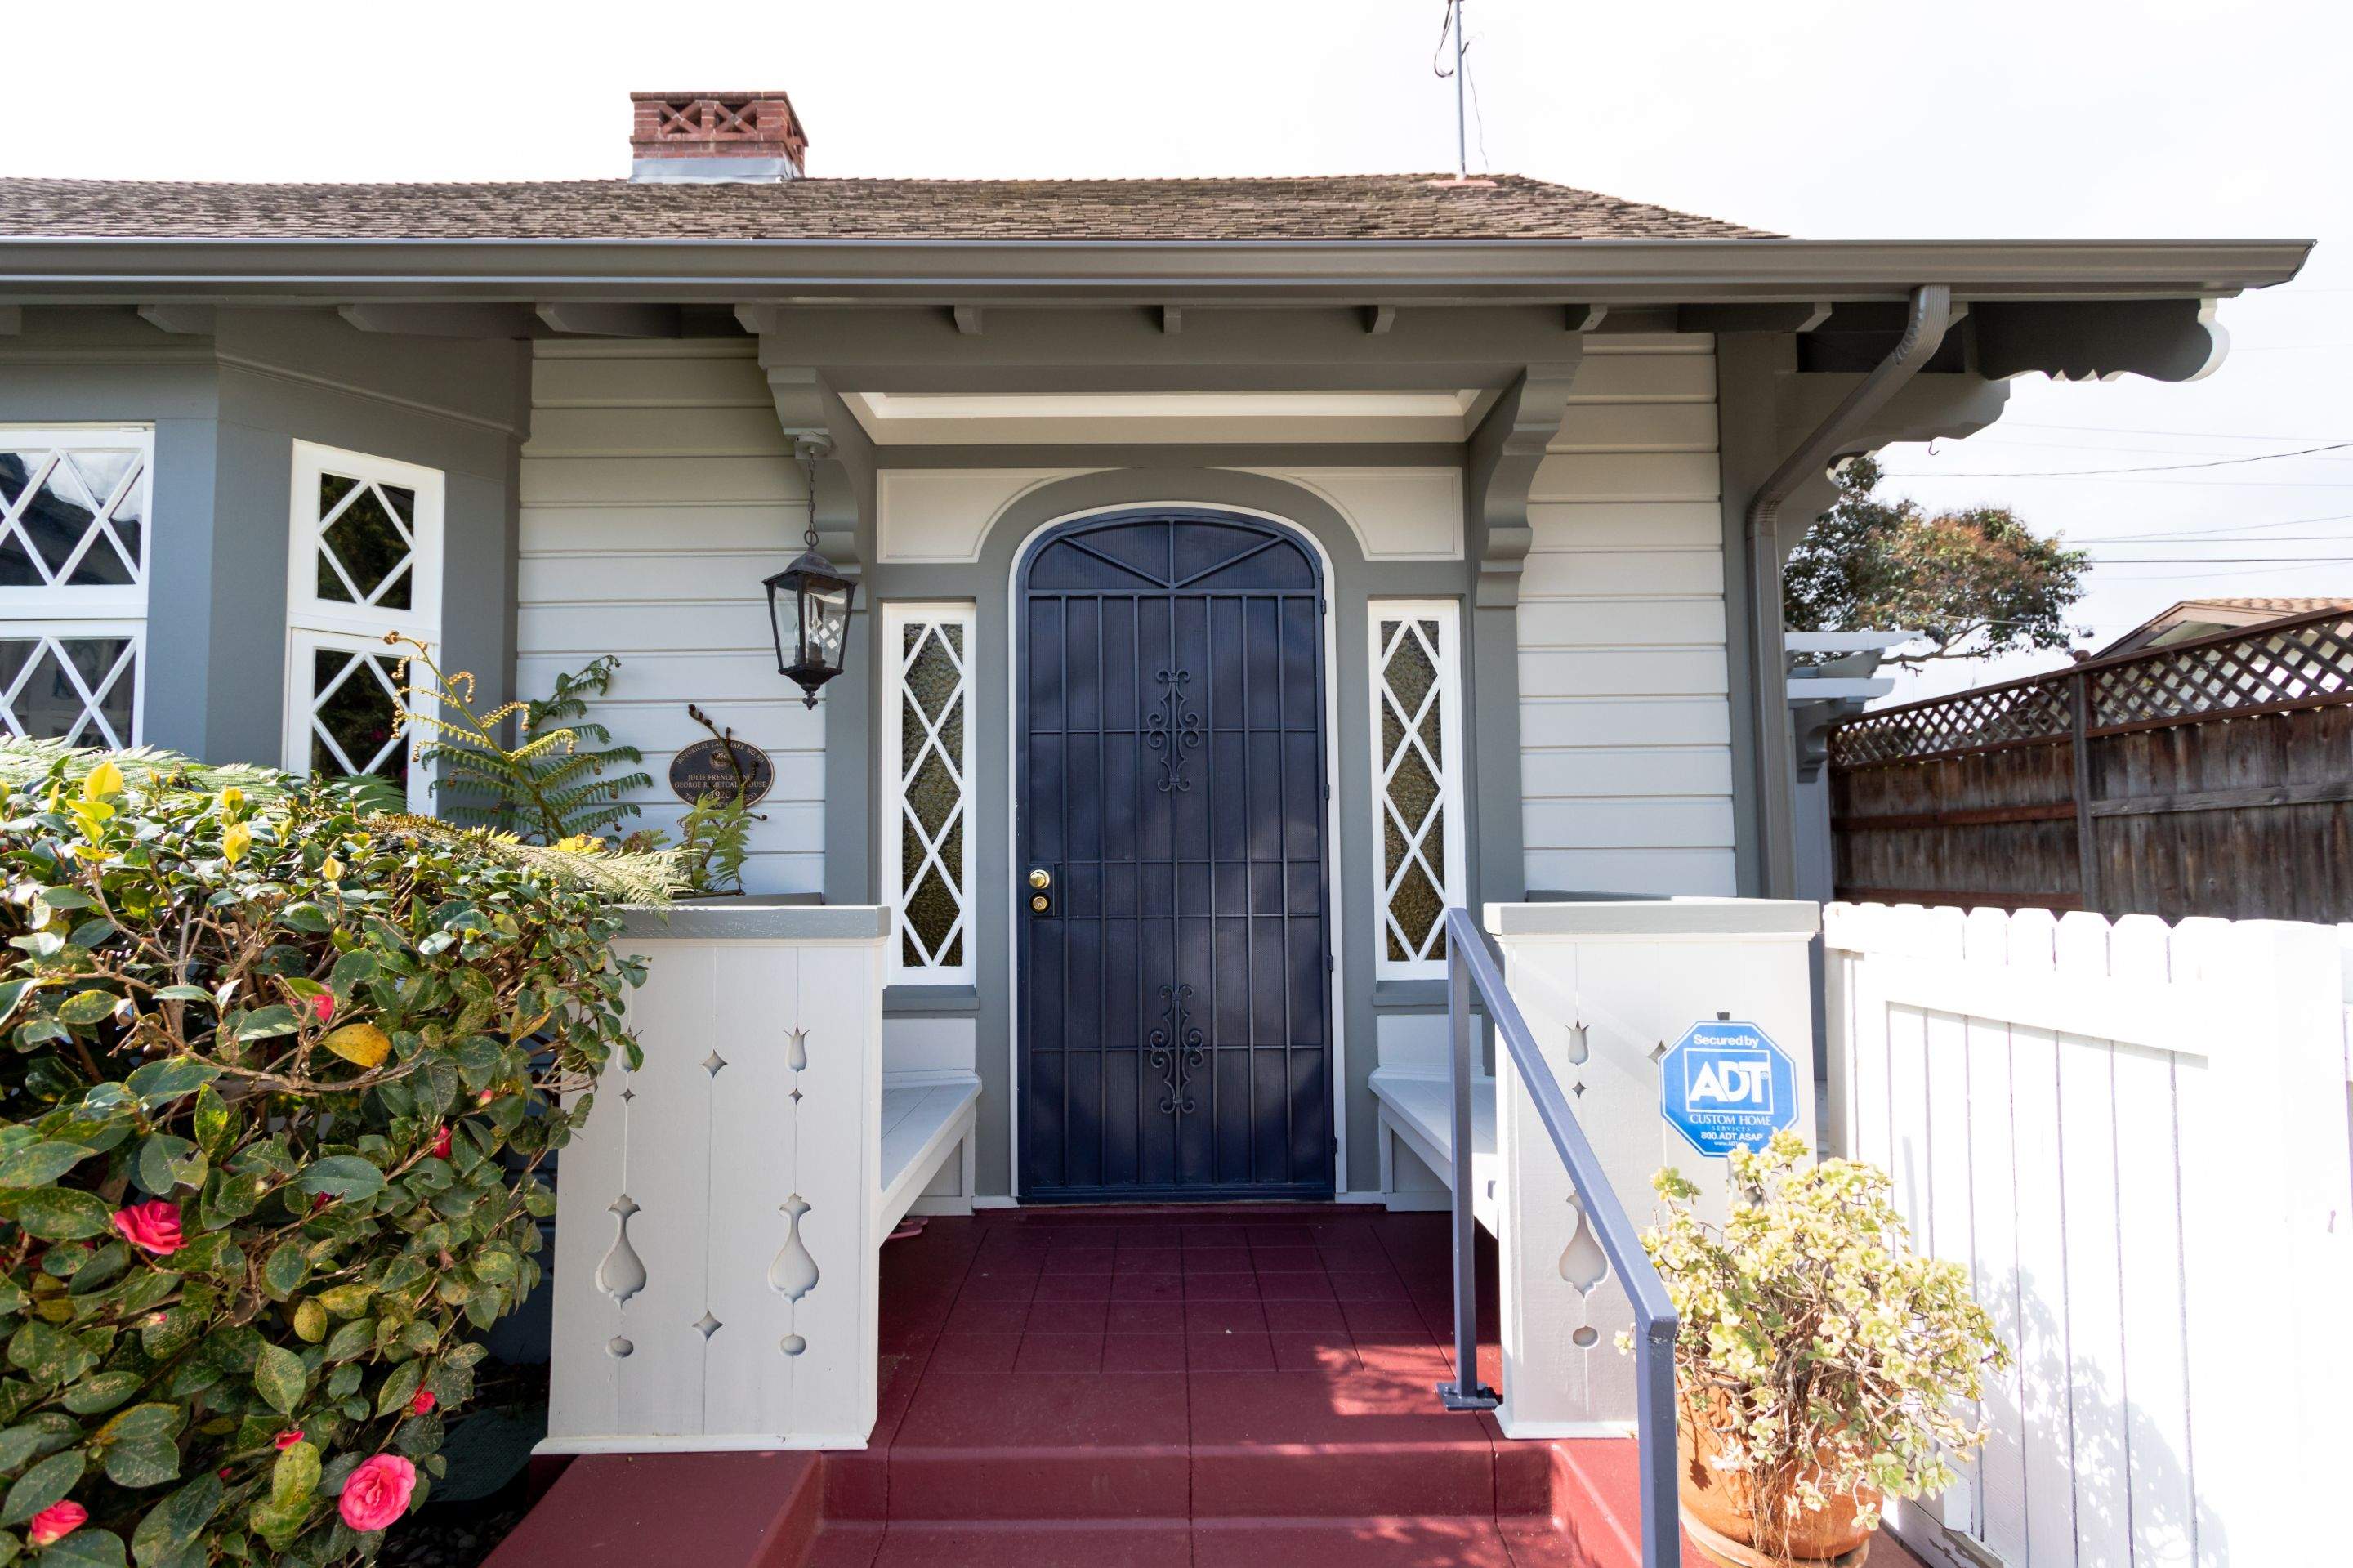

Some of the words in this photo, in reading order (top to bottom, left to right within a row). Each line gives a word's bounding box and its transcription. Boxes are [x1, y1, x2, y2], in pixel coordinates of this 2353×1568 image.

[676, 743, 708, 764] HISTORICAL
[1694, 1034, 1744, 1047] Secured
[1744, 1035, 1759, 1048] by
[1688, 1061, 1768, 1103] ADT
[1690, 1114, 1735, 1124] CUSTOM
[1739, 1115, 1771, 1126] HOME
[1700, 1131, 1763, 1141] 800.ADT.ASAP
